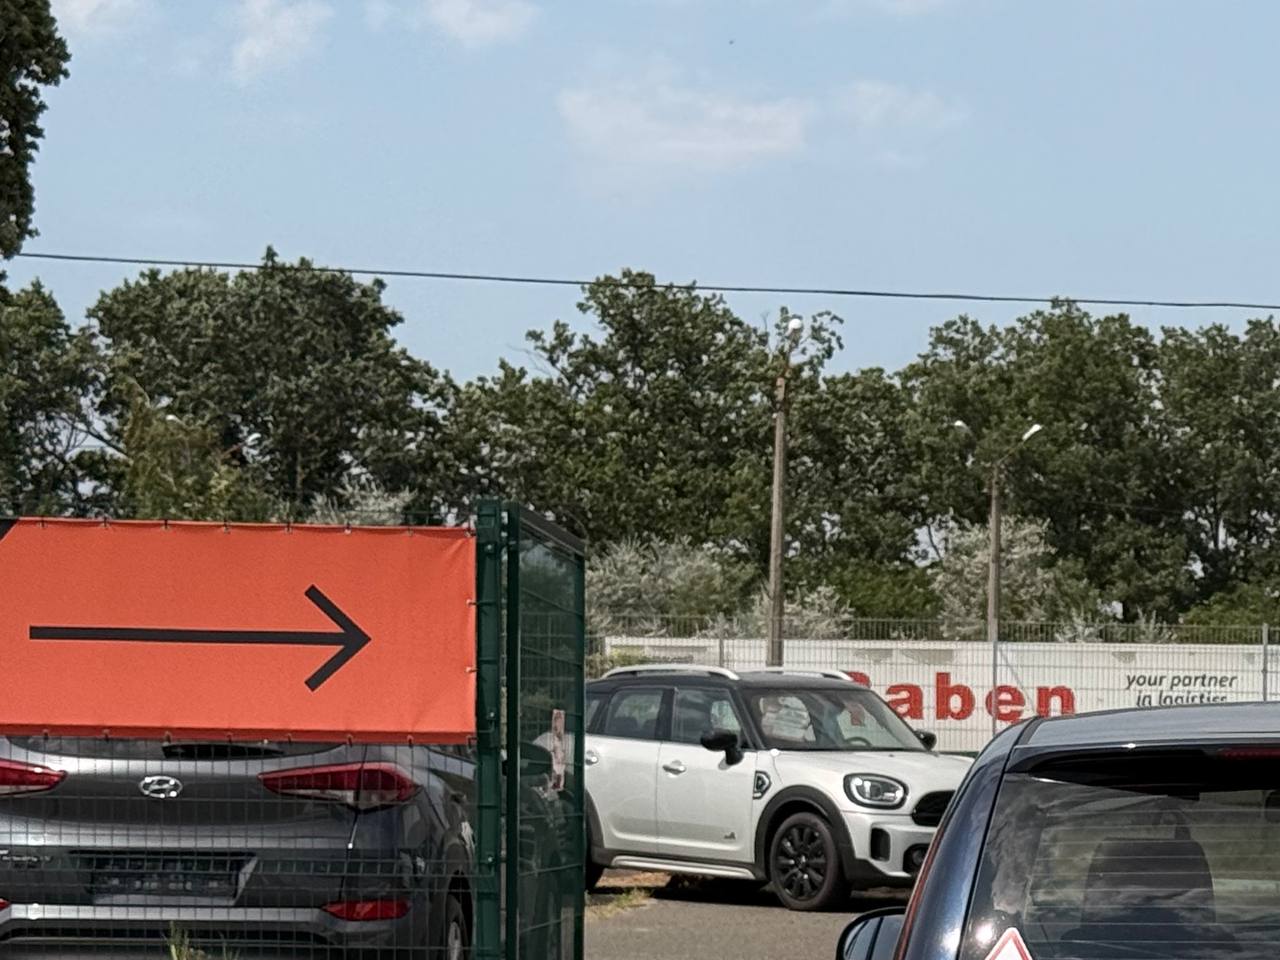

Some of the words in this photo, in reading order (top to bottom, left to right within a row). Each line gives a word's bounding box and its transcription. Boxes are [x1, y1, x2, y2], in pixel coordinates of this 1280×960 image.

[1126, 674, 1167, 690] your
[1170, 674, 1238, 690] partner
[1136, 690, 1152, 707] in
